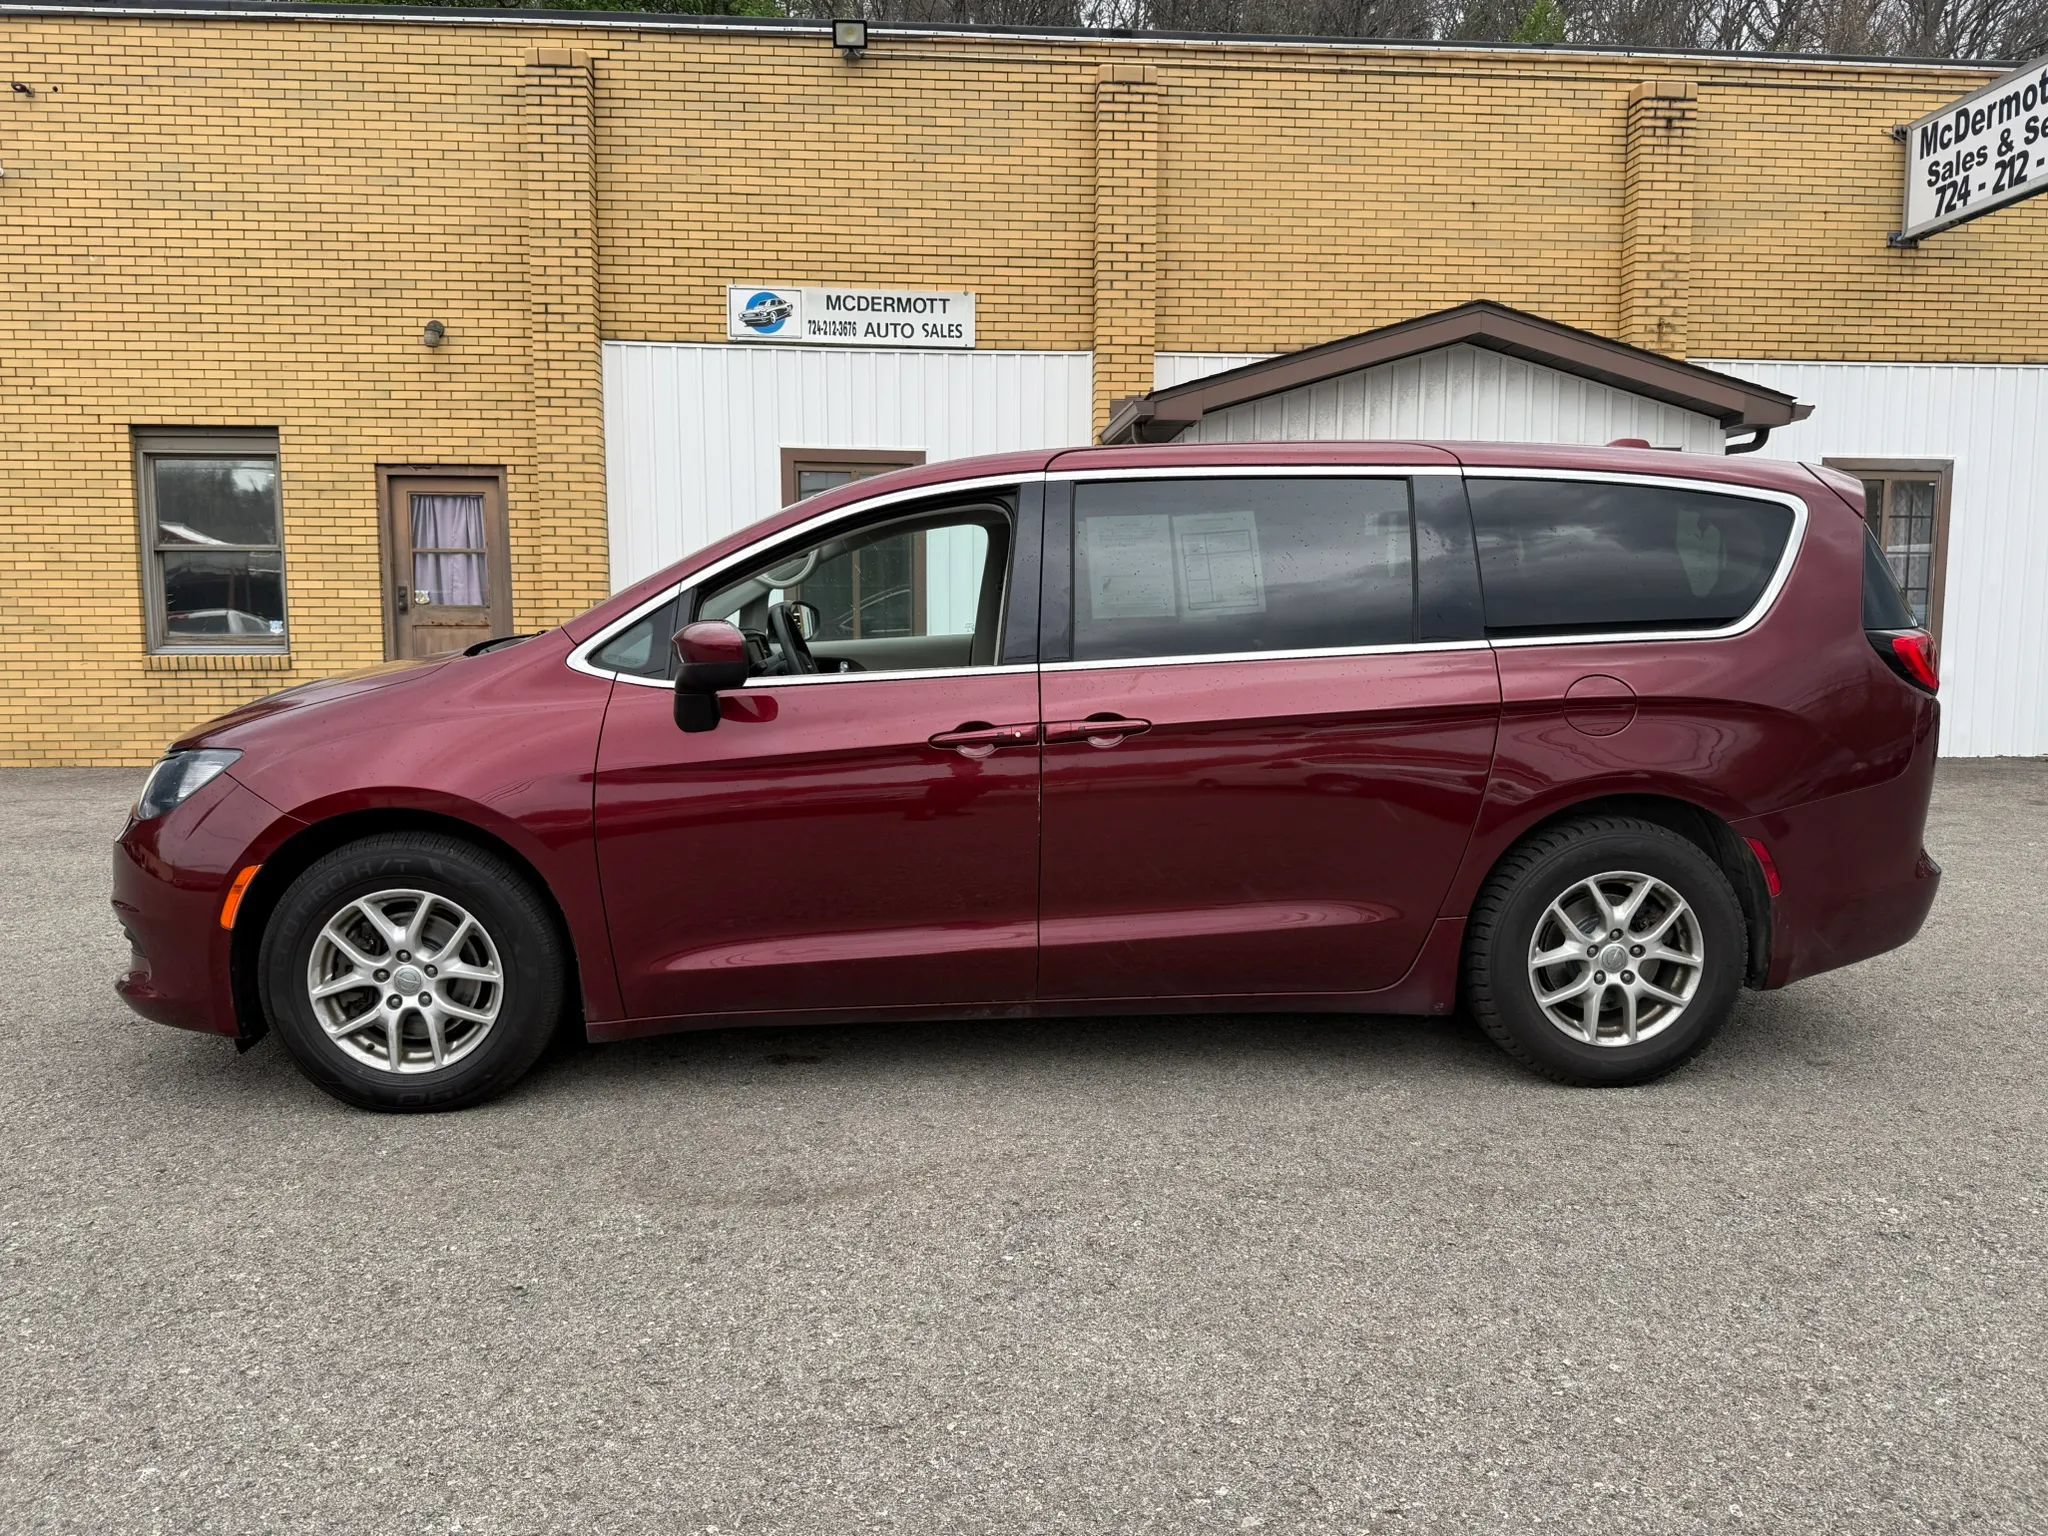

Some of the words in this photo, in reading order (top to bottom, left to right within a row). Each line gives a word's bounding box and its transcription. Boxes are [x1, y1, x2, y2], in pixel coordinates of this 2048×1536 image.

[1927, 145, 1988, 188] Sales
[1997, 127, 2014, 157] &
[1935, 174, 1971, 218] 724
[1991, 149, 2030, 196] 212
[825, 294, 951, 315] MCDERMOTT
[807, 319, 857, 337] 724-212-3676
[864, 321, 915, 339] AUTO
[921, 322, 963, 339] SALES
